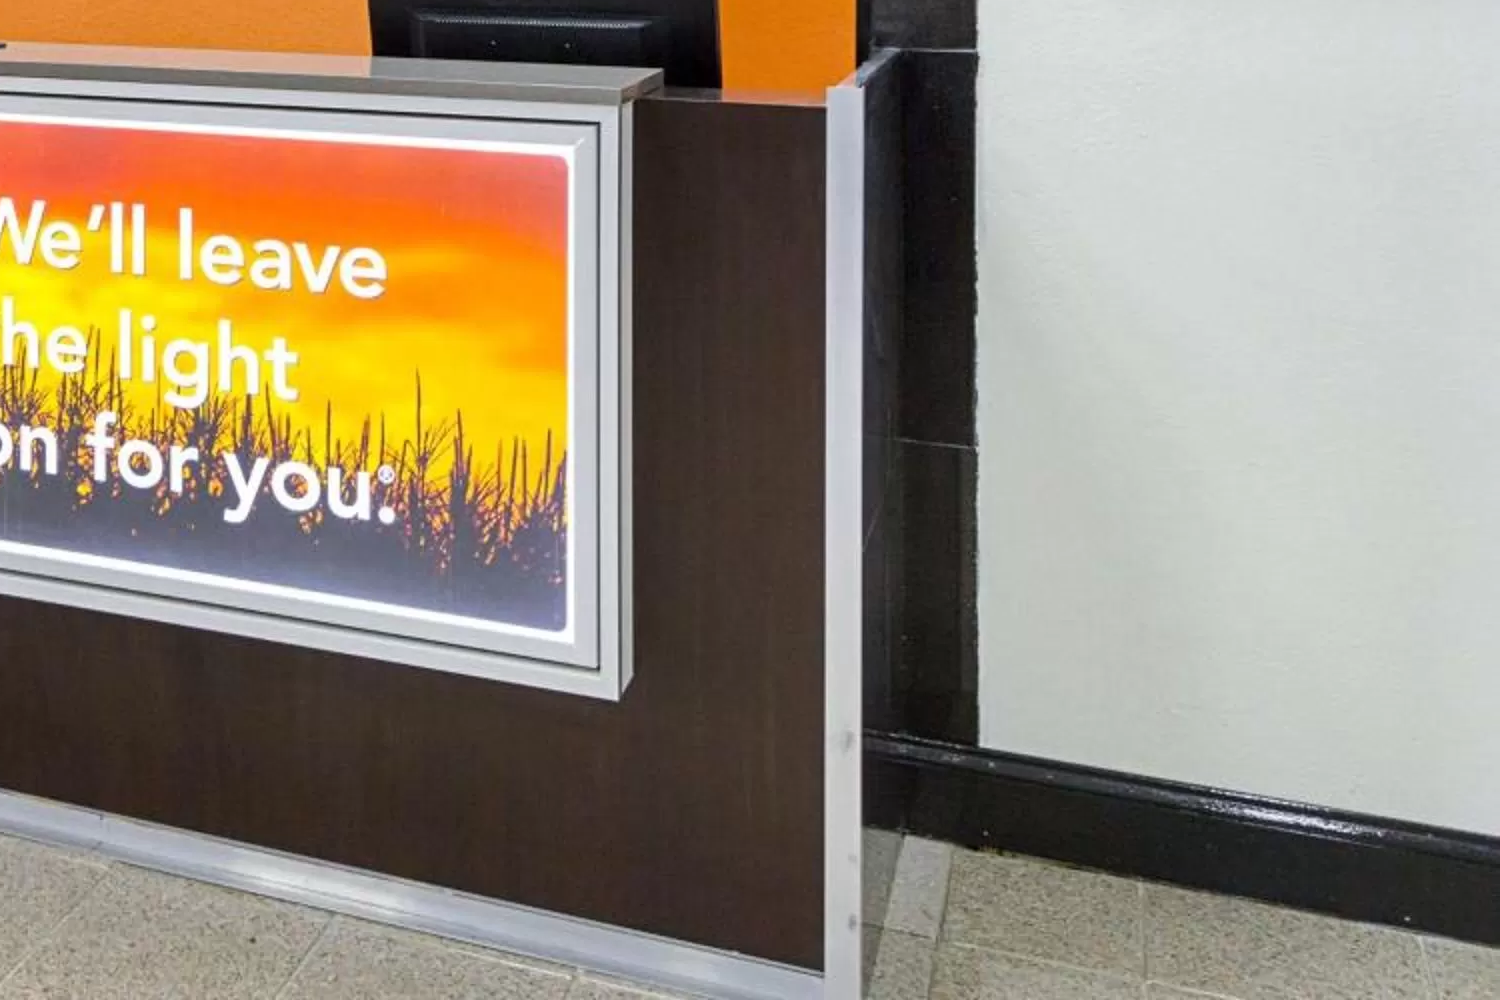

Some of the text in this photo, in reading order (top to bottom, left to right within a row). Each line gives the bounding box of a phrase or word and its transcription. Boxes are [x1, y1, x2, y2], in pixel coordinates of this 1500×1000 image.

[179, 207, 388, 299] leave
[118, 308, 300, 410] light
[86, 412, 199, 494] for
